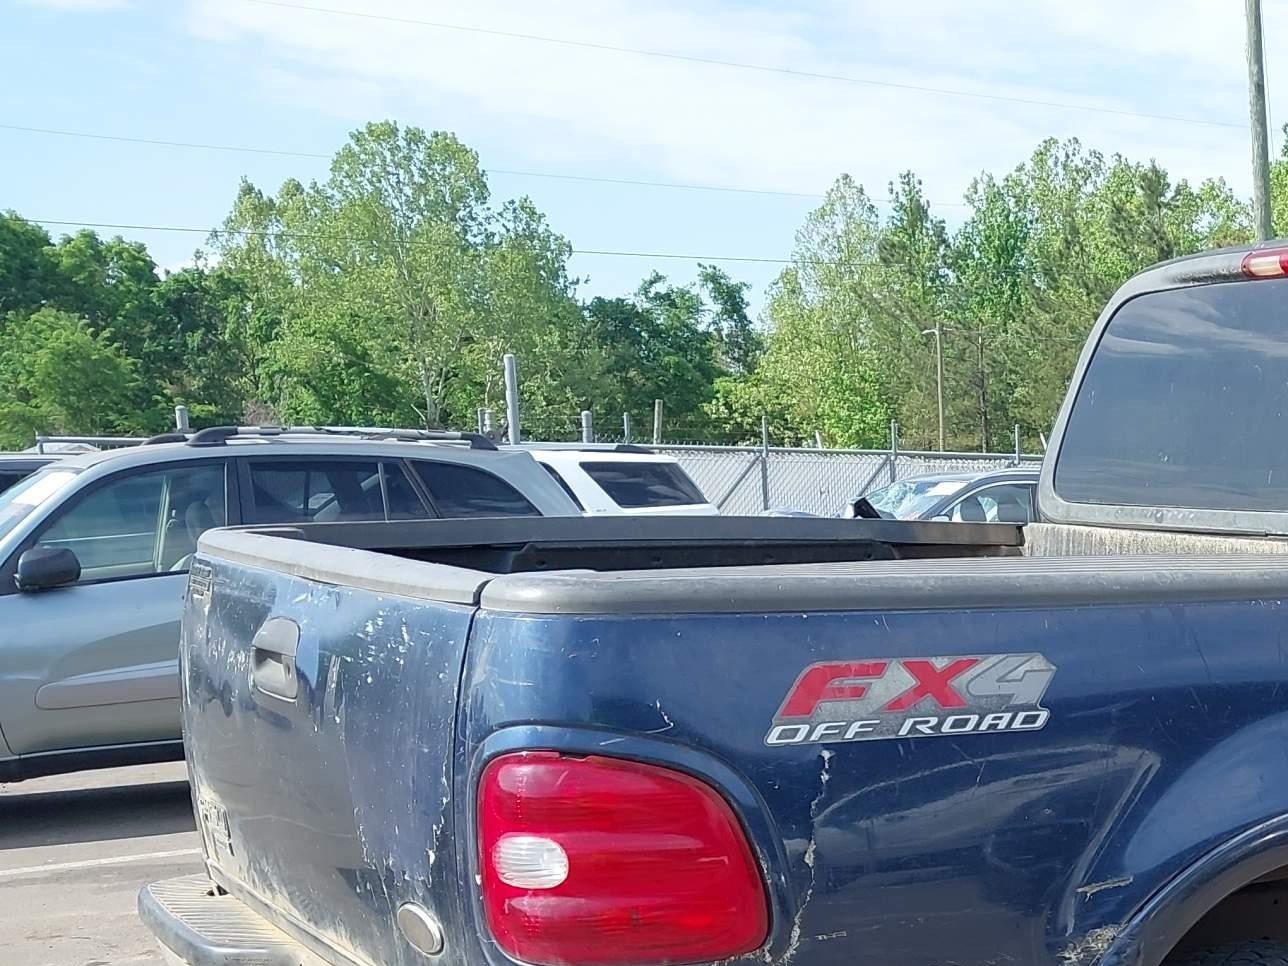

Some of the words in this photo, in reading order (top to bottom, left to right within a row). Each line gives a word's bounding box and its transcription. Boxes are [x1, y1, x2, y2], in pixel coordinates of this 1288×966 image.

[780, 654, 1056, 718] FX4
[766, 719, 880, 744] OFF
[897, 709, 1050, 736] ROAD
